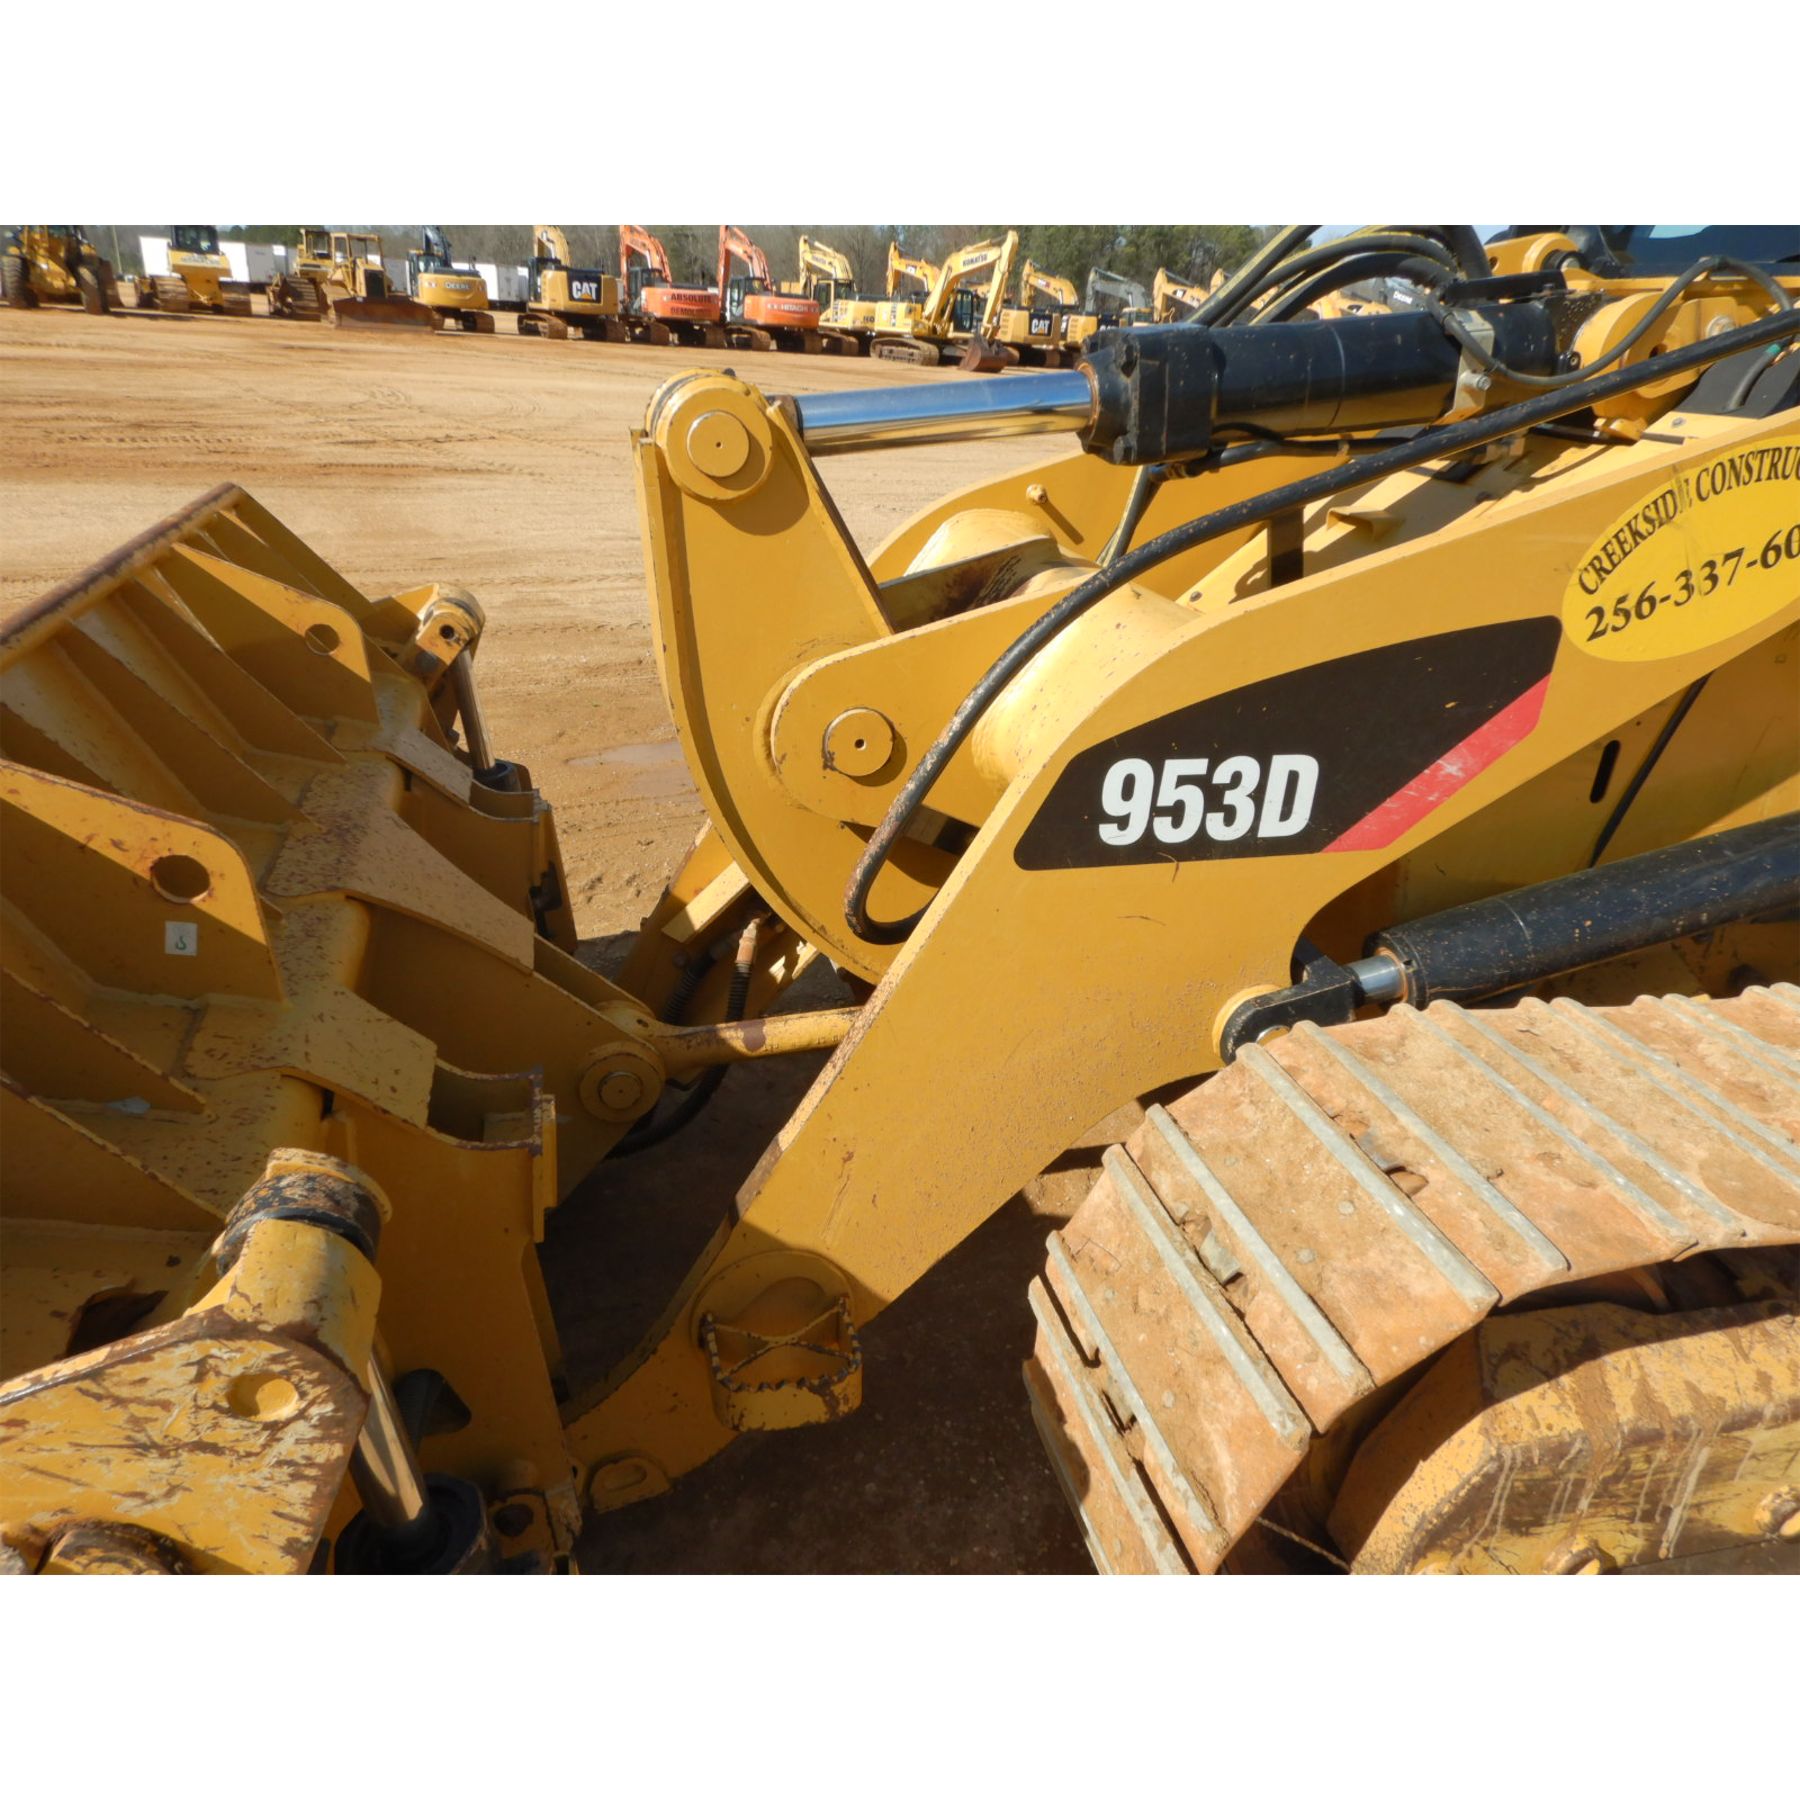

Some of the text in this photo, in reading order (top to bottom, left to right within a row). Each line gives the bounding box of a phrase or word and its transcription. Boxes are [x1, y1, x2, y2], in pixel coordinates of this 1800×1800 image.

[572, 281, 598, 300] CAT
[1031, 319, 1050, 334] CAT
[1695, 446, 1800, 502] CONSTRU
[1098, 754, 1320, 846] 953D
